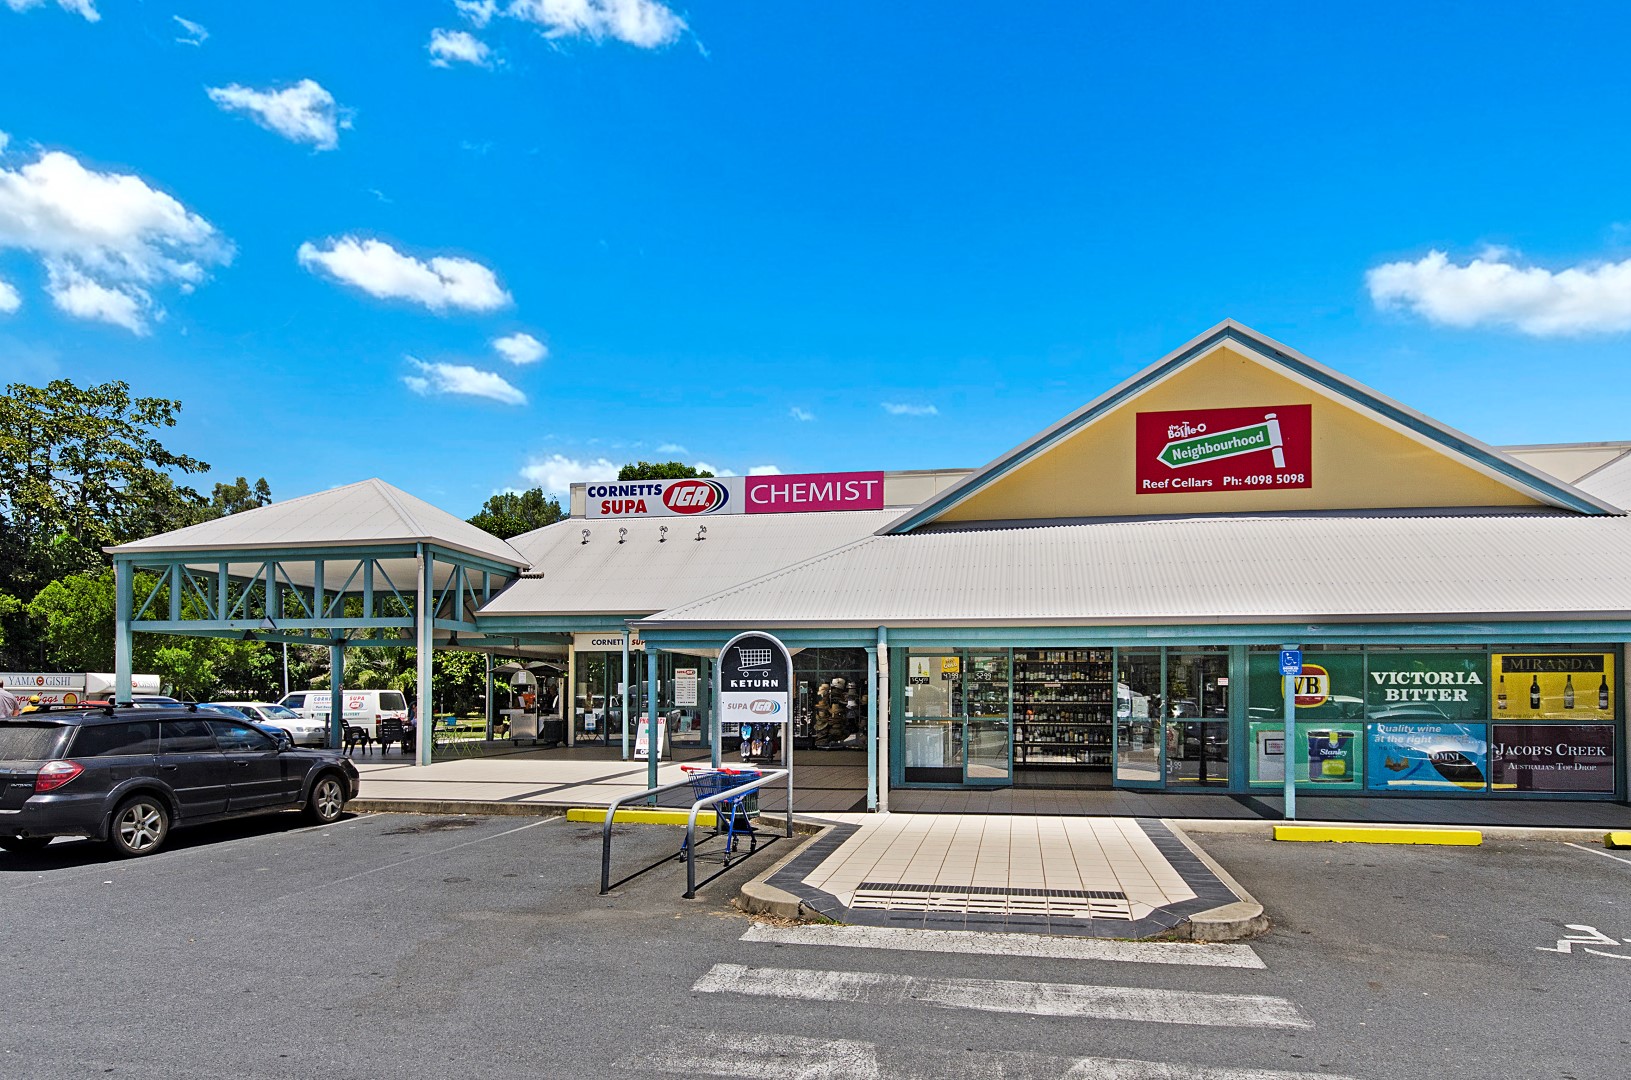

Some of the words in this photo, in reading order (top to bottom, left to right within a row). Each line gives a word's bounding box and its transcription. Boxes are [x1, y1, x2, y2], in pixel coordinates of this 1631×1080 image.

[1172, 431, 1265, 460] Neighbourhood
[1143, 479, 1170, 489] Reef
[1172, 478, 1213, 488] Cellars
[1223, 476, 1242, 486] Ph:
[1244, 475, 1273, 486] 4098
[1276, 474, 1305, 484] 5098
[588, 484, 662, 498] CORNETTS
[668, 486, 710, 507] IGA
[750, 480, 879, 504] CHEMIST
[601, 499, 648, 514] SUPA
[591, 638, 624, 646] CORNETT
[1510, 658, 1595, 670] MIRANDA
[730, 679, 779, 688] RETURN
[1370, 671, 1484, 685] VICTORIA
[1294, 676, 1322, 695] VB
[1385, 688, 1468, 702] BITTER
[727, 702, 748, 710] SUPA
[1377, 725, 1414, 734] Quality
[1417, 725, 1442, 733] wine
[1374, 735, 1385, 743] at
[1387, 735, 1404, 743] the
[1406, 735, 1432, 745] right
[1320, 749, 1347, 757] Stanley
[1555, 743, 1606, 756] CREEK
[1432, 752, 1460, 761] OMNI
